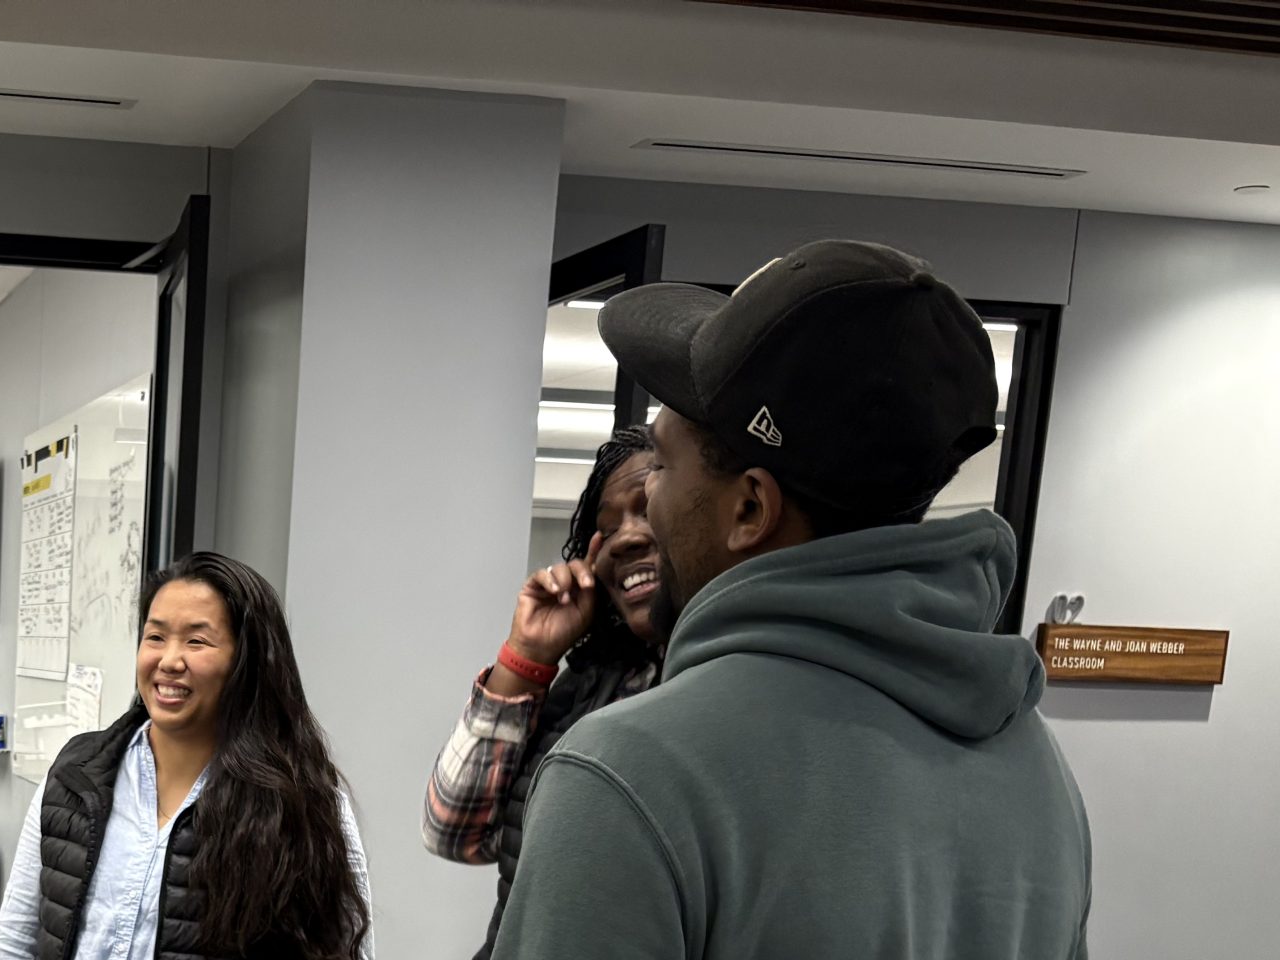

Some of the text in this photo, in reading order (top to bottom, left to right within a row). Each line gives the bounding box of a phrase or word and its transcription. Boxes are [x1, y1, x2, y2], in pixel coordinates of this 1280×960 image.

[1054, 637, 1185, 655] THE WAYNE AND JOAN WEBBER
[1051, 656, 1105, 670] CLASSROOM
